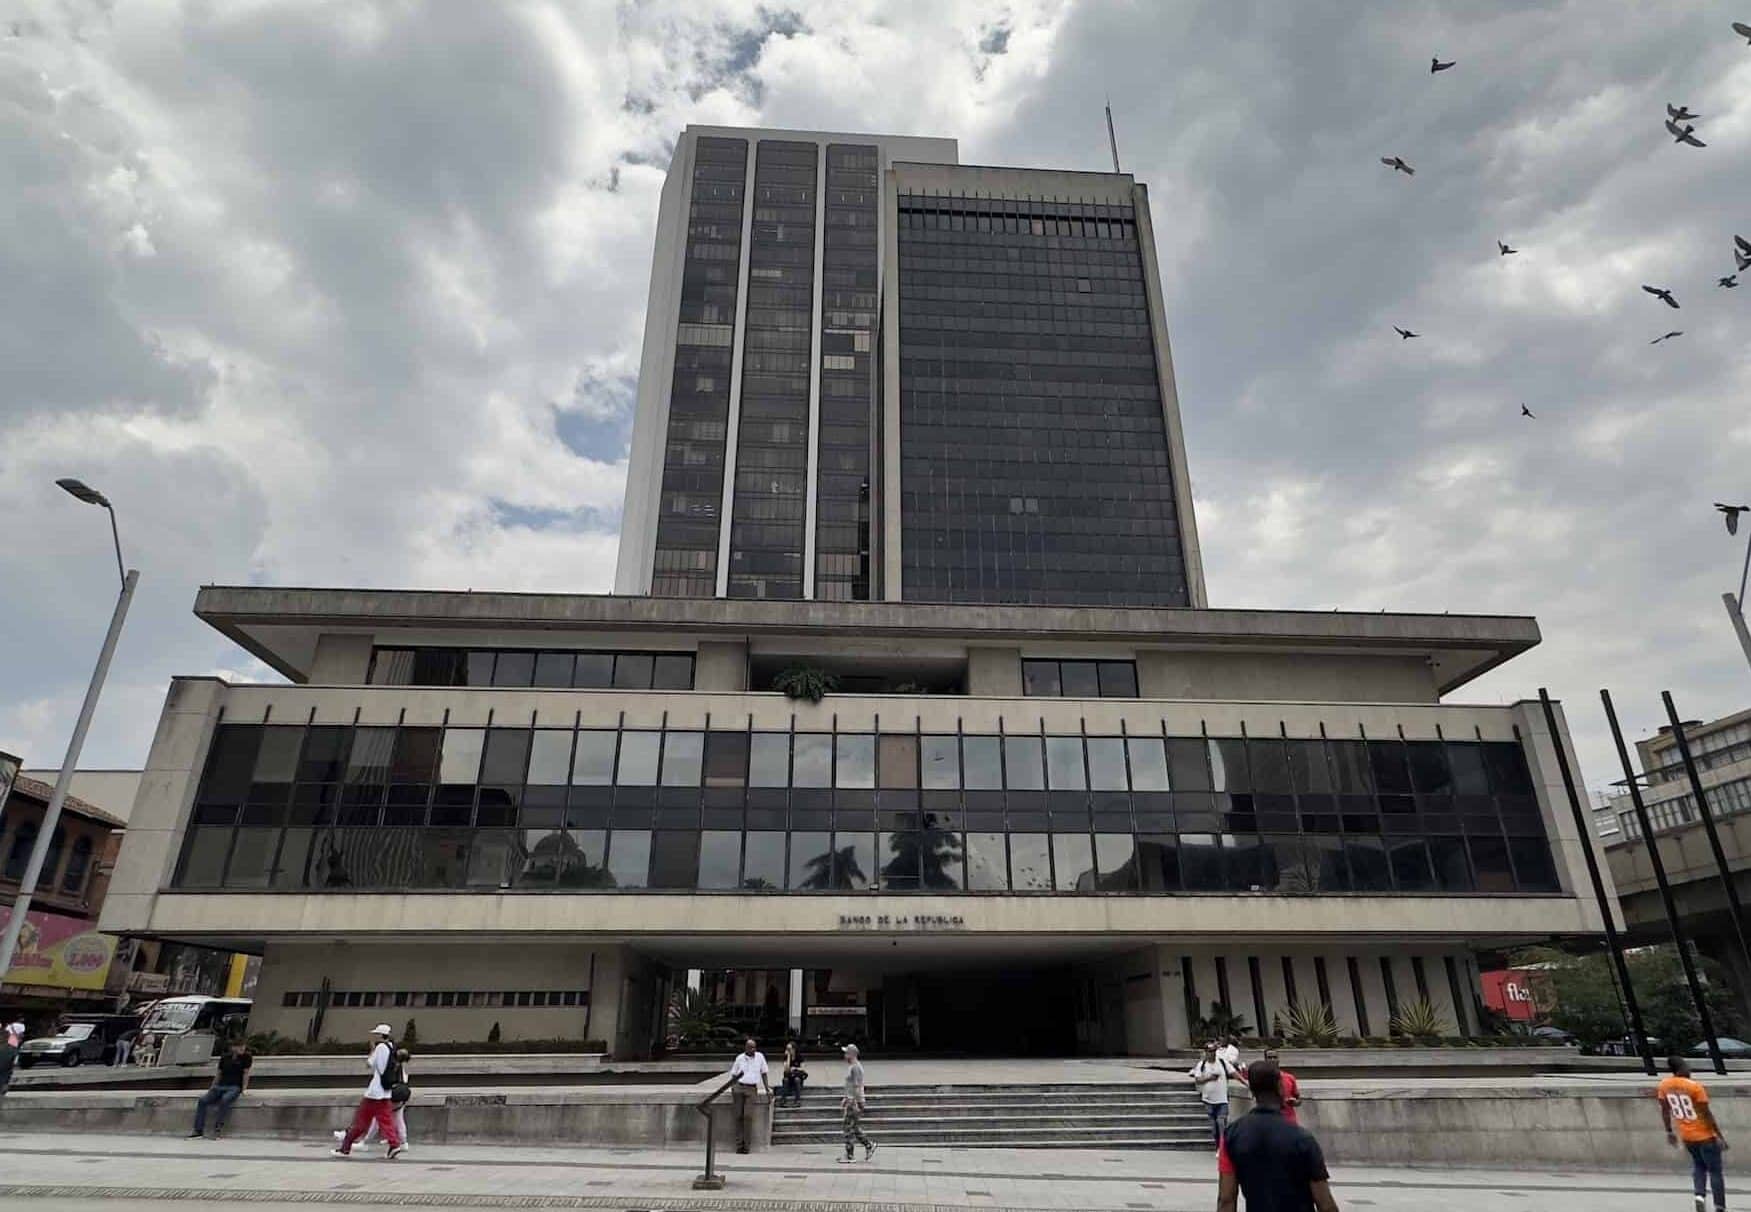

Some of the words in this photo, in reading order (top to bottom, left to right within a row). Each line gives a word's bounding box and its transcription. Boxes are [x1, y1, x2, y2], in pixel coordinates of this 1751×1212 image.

[839, 915, 871, 925] BANCO
[877, 915, 889, 925] DE
[896, 915, 908, 925] LA
[1666, 1093, 1698, 1121] 88
